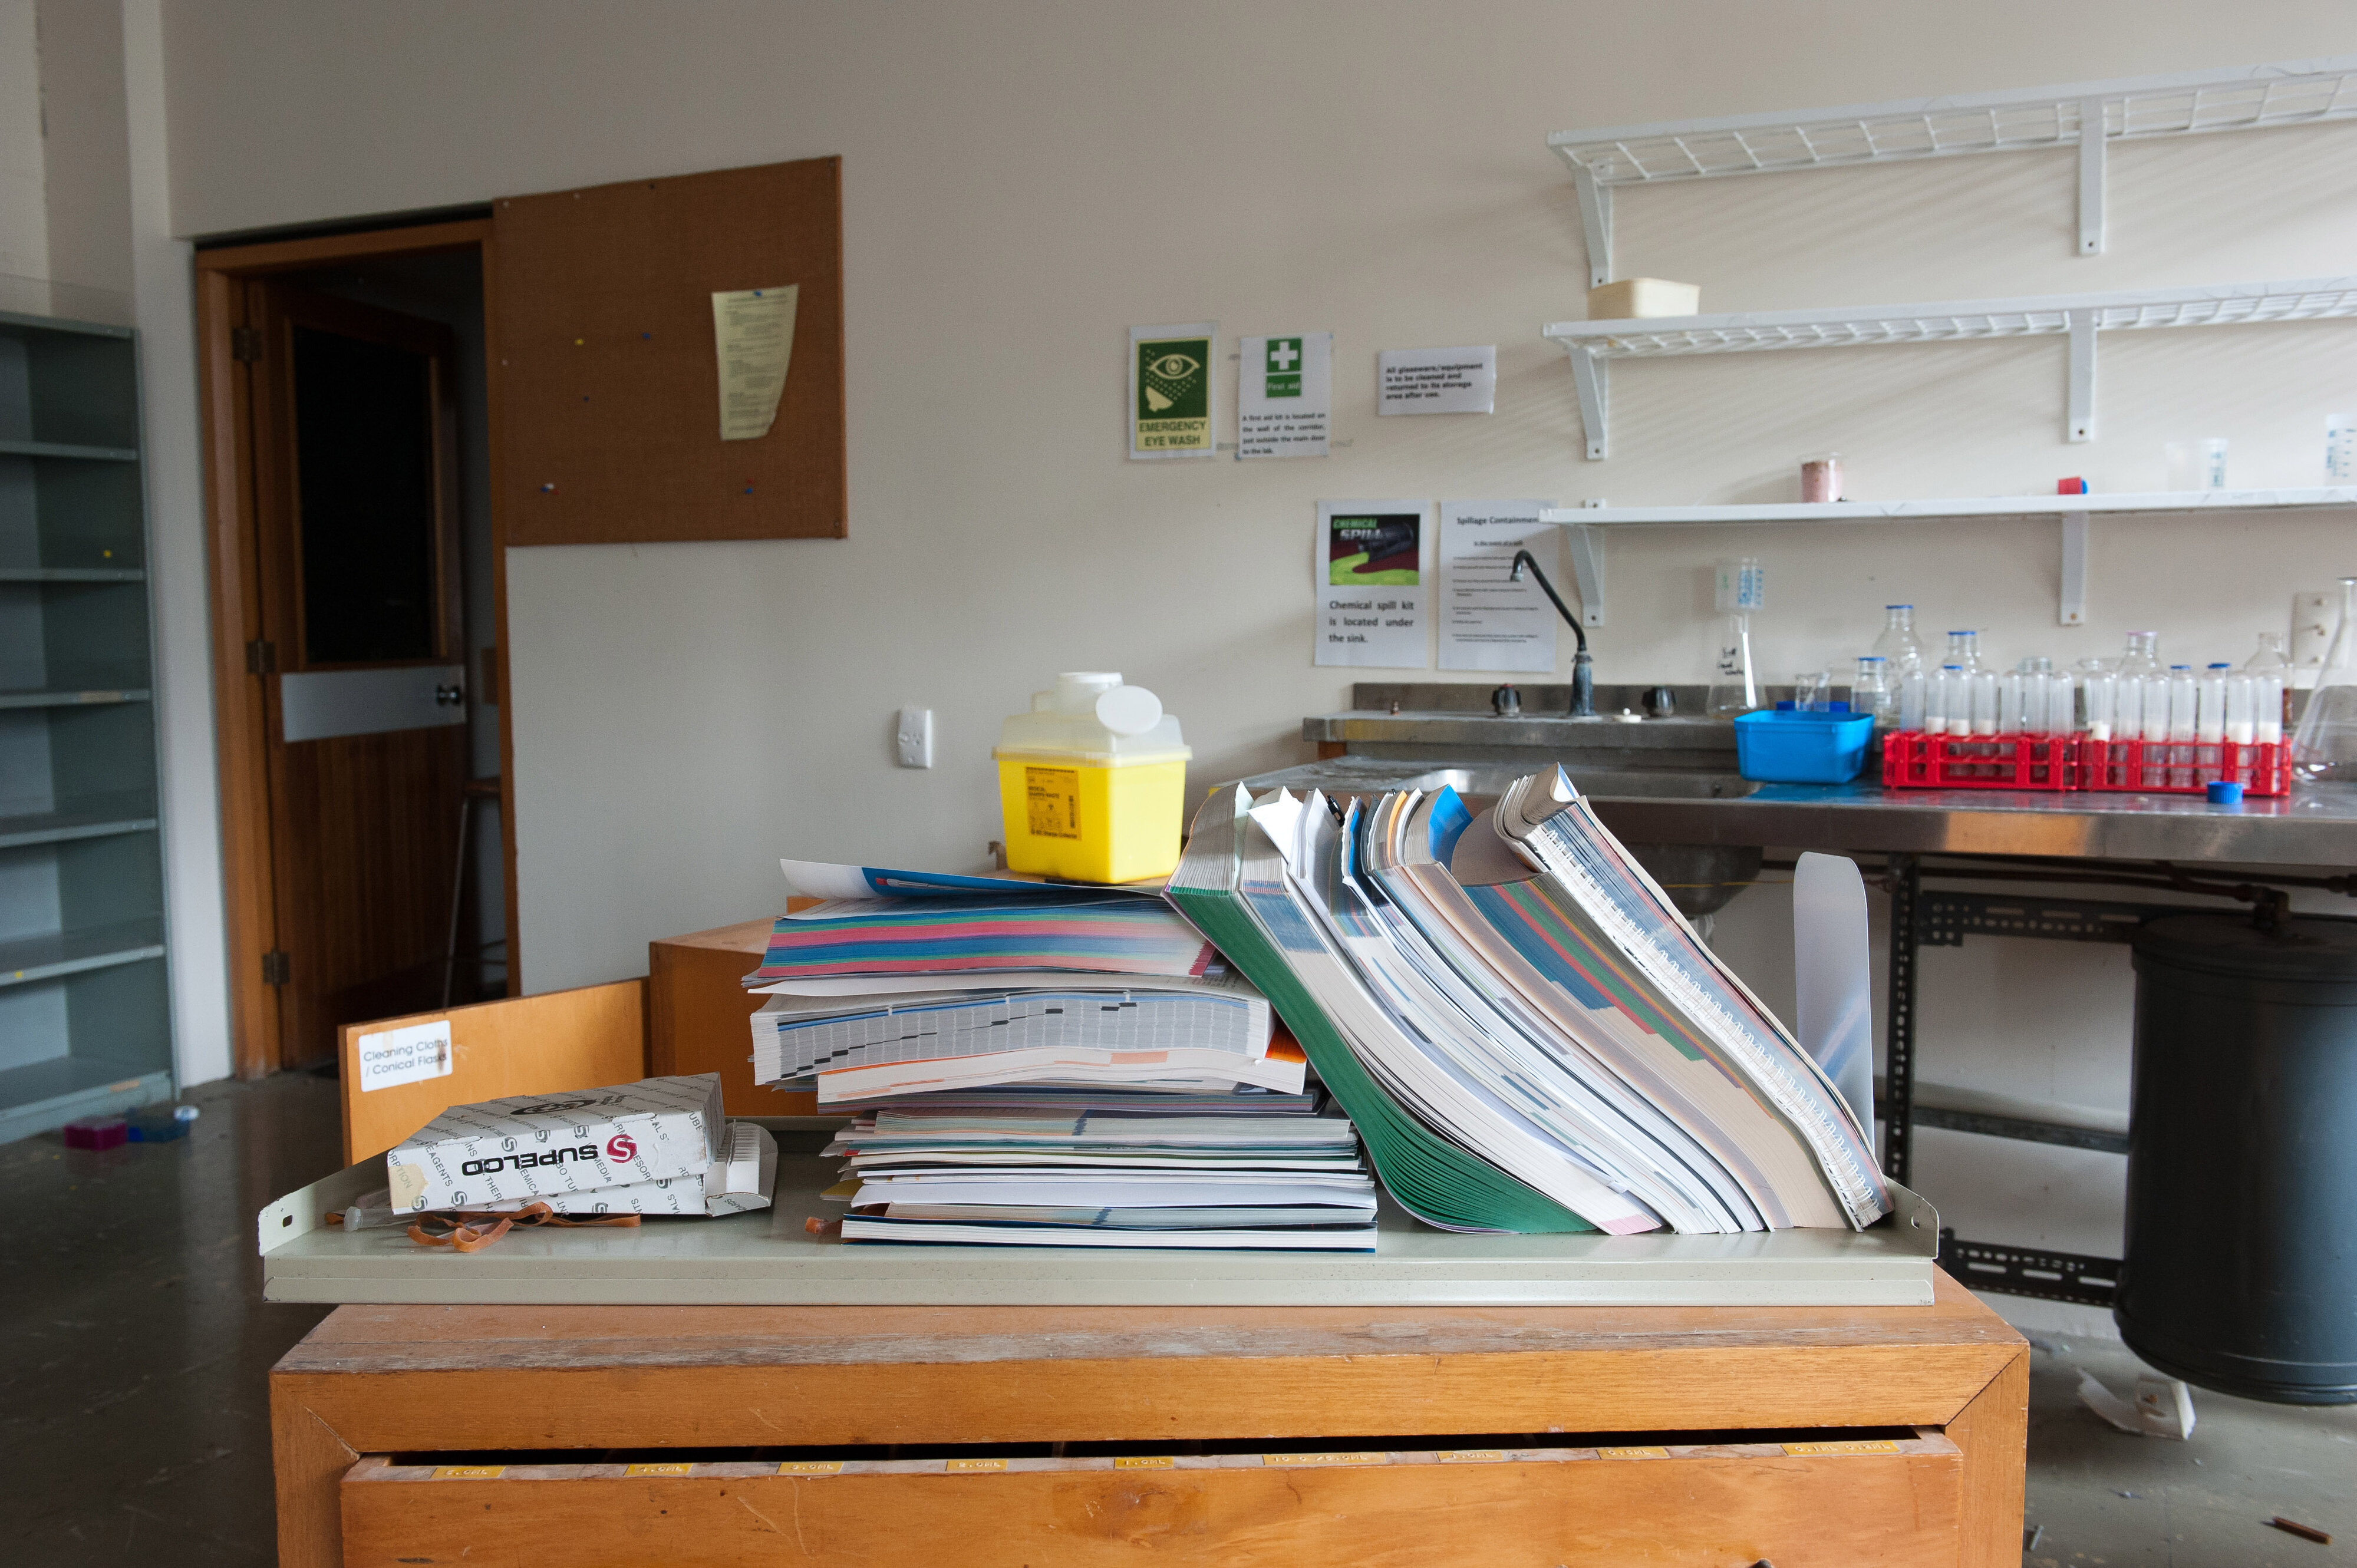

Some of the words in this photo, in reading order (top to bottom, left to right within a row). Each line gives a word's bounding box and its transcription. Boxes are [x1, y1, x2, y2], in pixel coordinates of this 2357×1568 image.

[1139, 421, 1206, 433] EMERGENCY
[1145, 436, 1165, 446] EYE
[1168, 435, 1201, 445] WASH
[1457, 516, 1487, 526] Spillage
[1340, 529, 1381, 540] SPILL
[1329, 600, 1372, 609] Chemical
[1377, 600, 1397, 611] spill
[1402, 600, 1413, 609] kit
[1329, 617, 1336, 626] is
[1344, 617, 1378, 626] located
[1385, 618, 1413, 626] under
[1329, 633, 1344, 642] the
[1347, 633, 1368, 642] sink.
[364, 1045, 413, 1062] Cleaning
[416, 1038, 447, 1051] Cloths
[372, 1059, 414, 1075] Conical
[418, 1053, 447, 1067] Flasks
[462, 1145, 598, 1176] SUPELCO
[485, 1176, 504, 1201] THER
